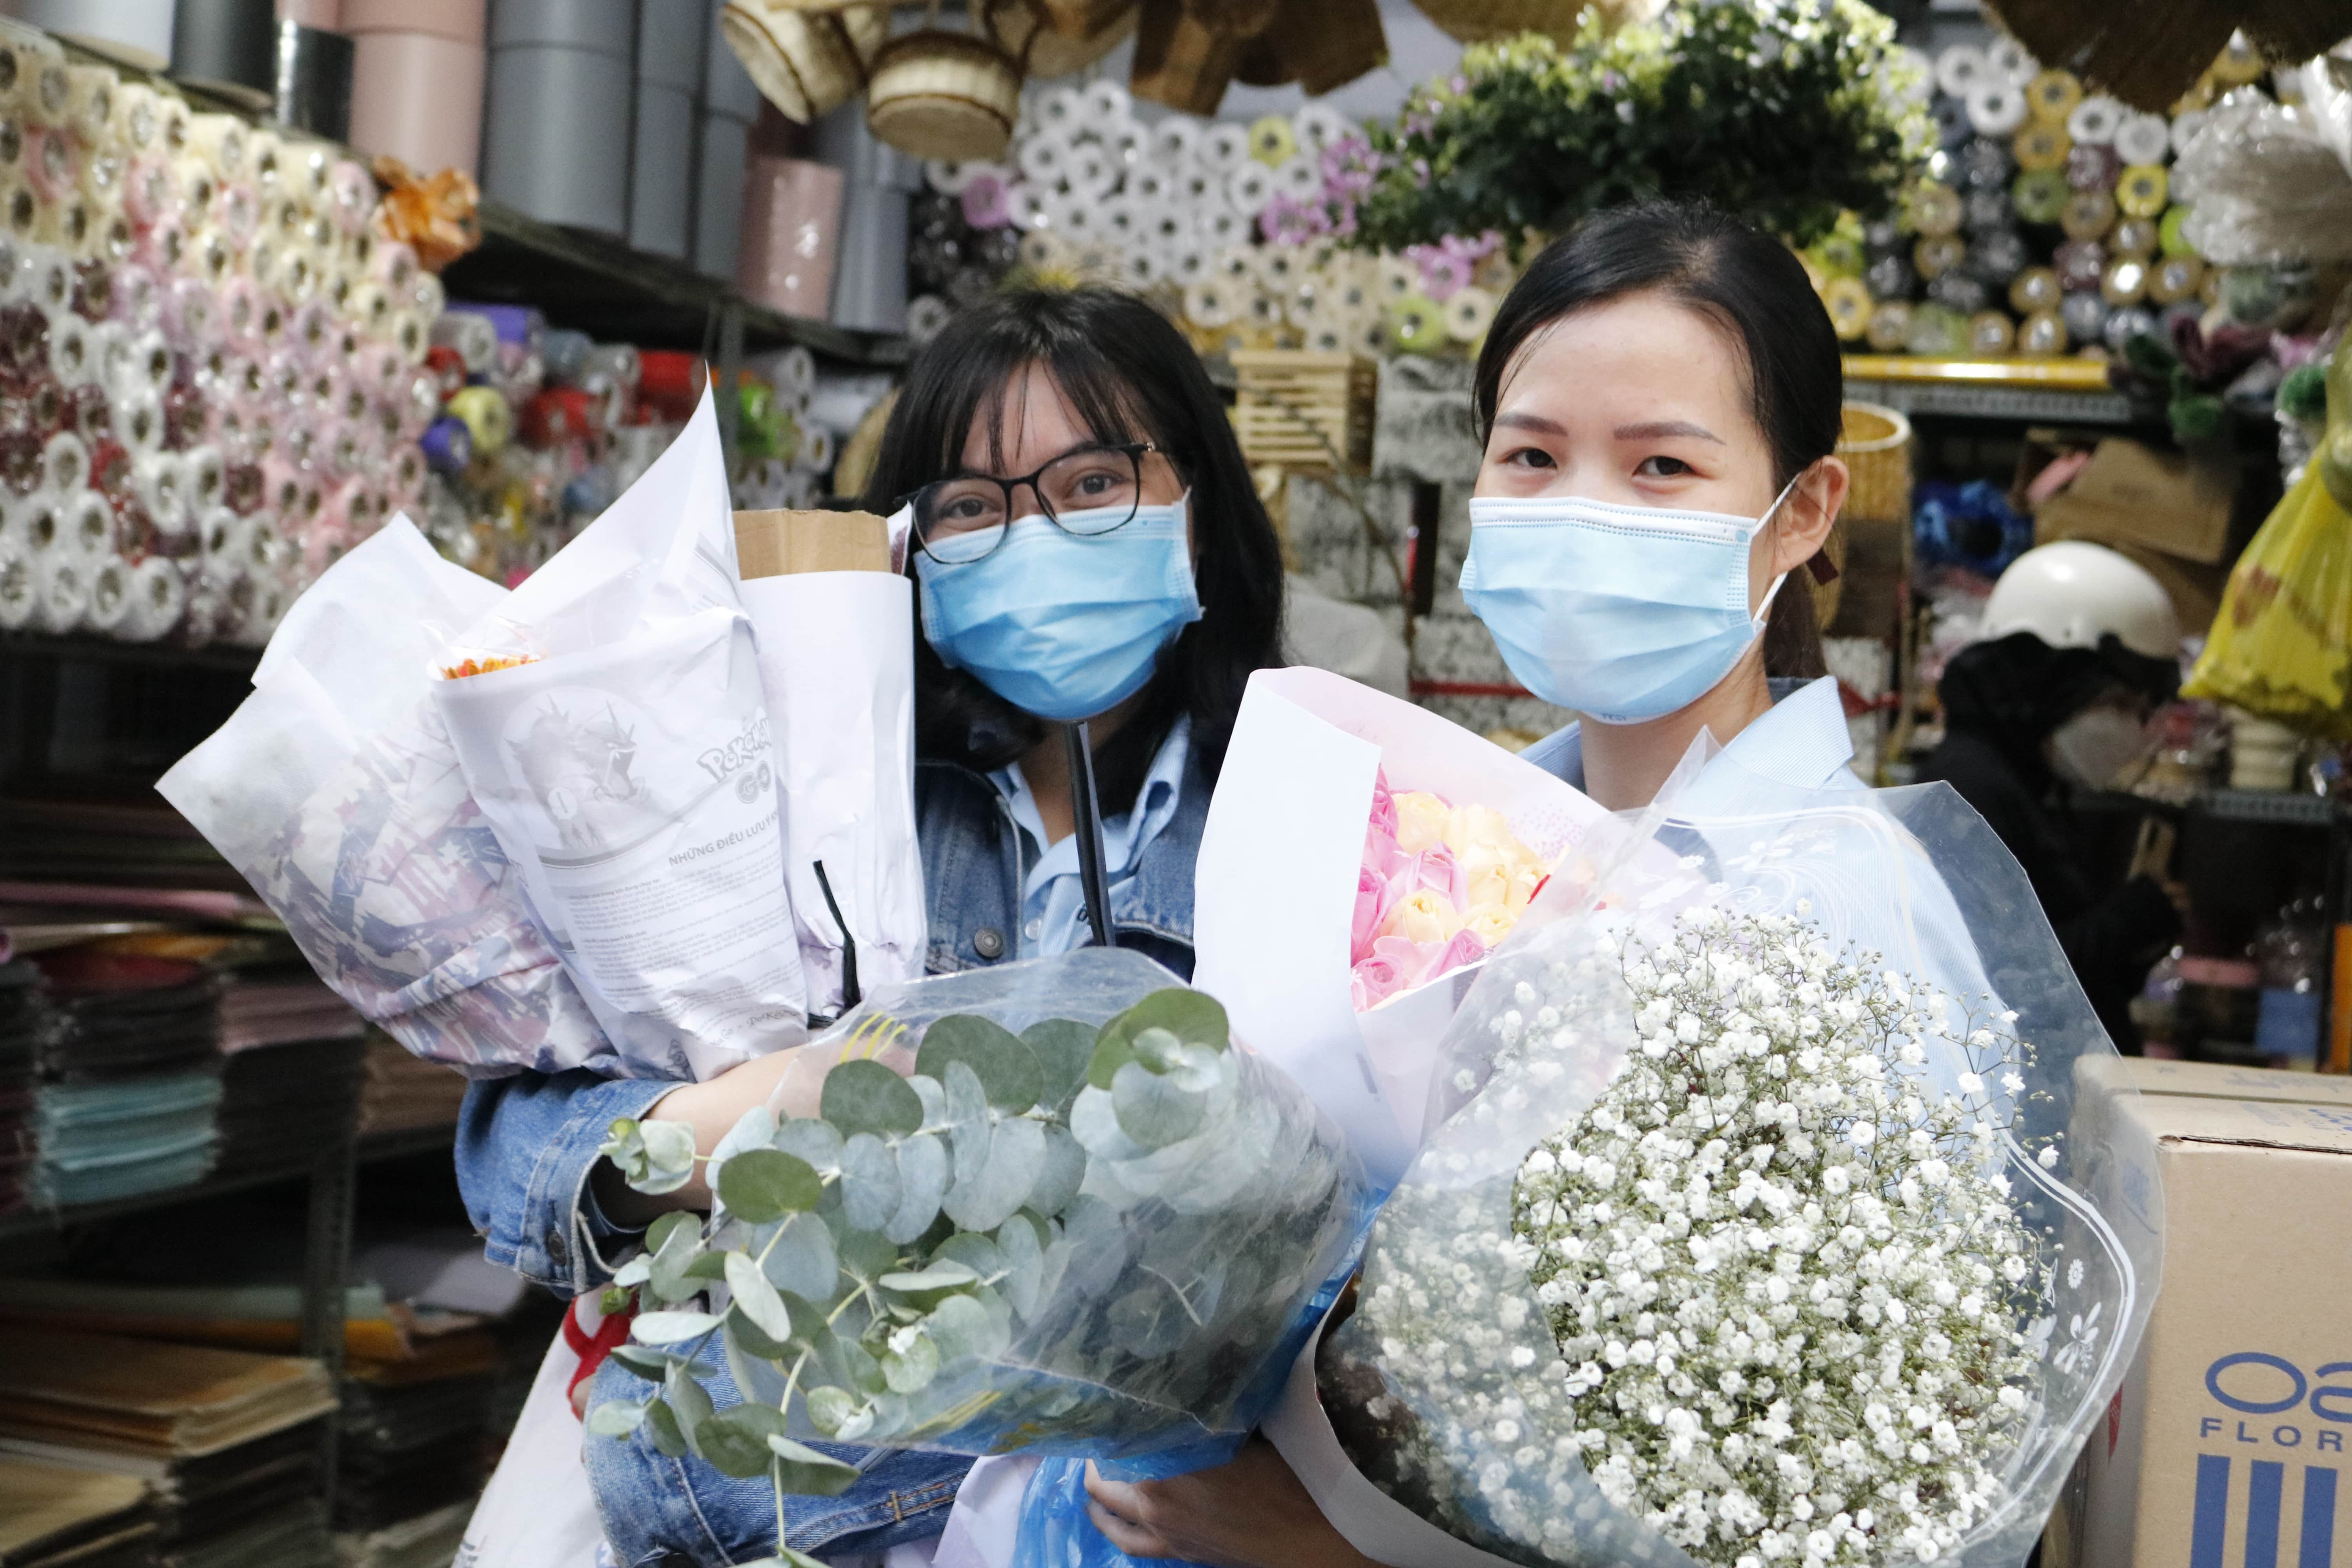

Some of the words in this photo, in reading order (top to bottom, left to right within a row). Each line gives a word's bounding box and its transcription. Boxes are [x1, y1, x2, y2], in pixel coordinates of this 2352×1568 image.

[735, 760, 771, 804] GO
[668, 842, 715, 867] NHỮNG
[2199, 1417, 2343, 1451] FLOR
